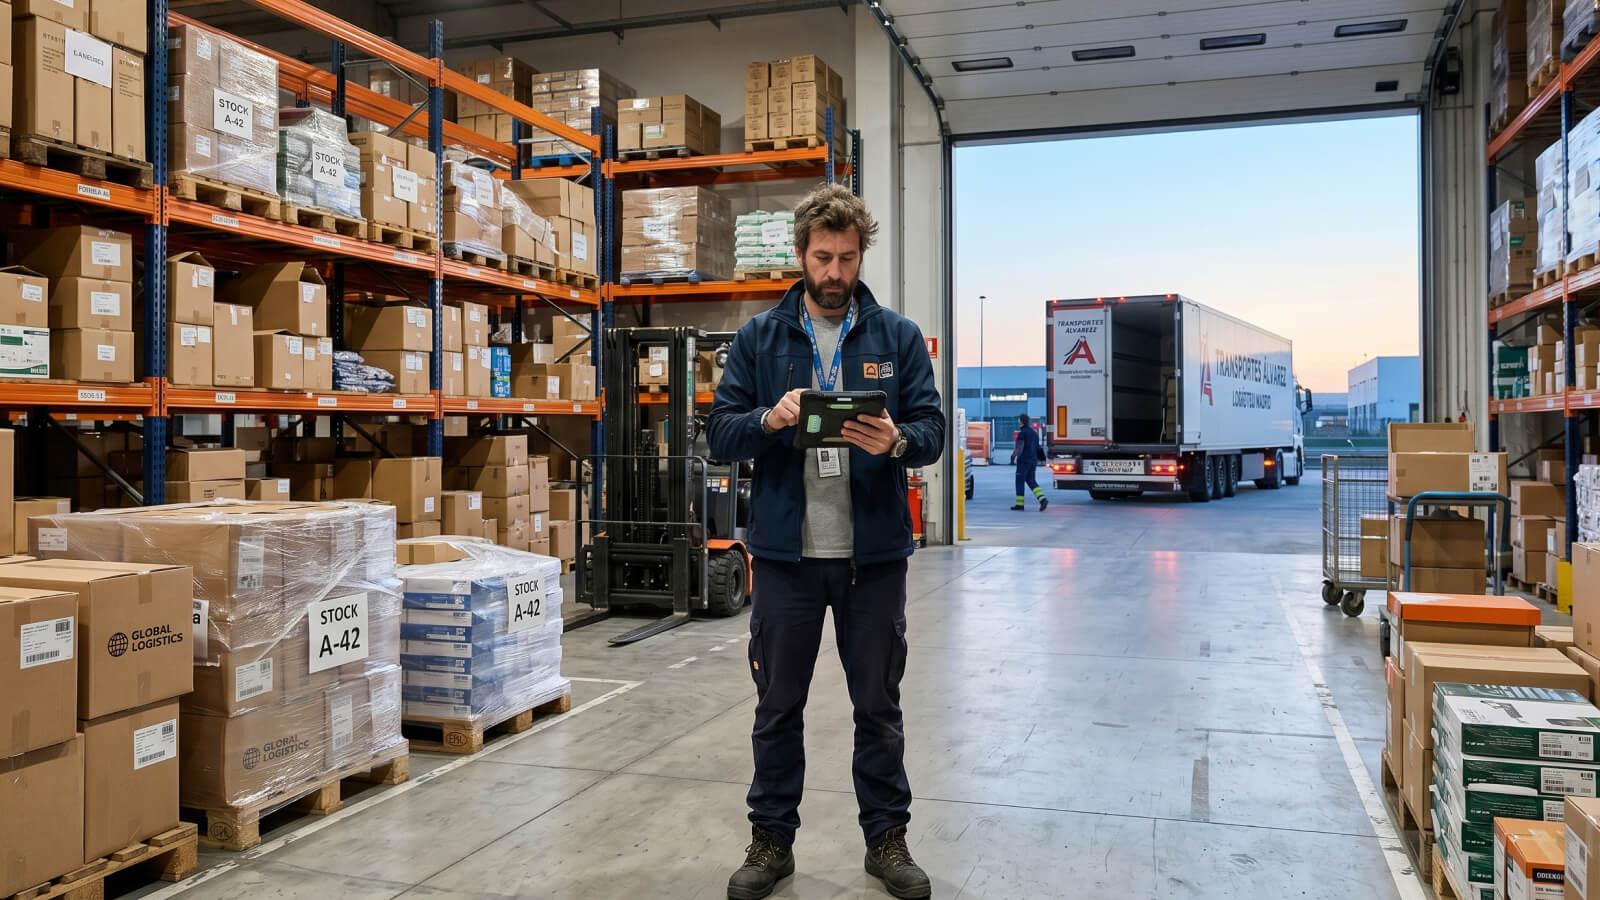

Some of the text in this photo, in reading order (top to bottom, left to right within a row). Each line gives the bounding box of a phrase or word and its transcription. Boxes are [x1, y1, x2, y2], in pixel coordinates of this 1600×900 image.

[218, 98, 249, 116] STOCK
[224, 115, 244, 128] A-42
[315, 151, 341, 166] STOCK
[319, 166, 337, 178] A-42
[1216, 349, 1262, 383] TRANSPORTES
[514, 579, 539, 596] STOCK
[320, 603, 358, 625] STOCK
[514, 599, 540, 623] A-42
[131, 624, 173, 641] GLOBAL
[131, 632, 184, 652] LOGISTICS
[318, 627, 361, 658] A-42
